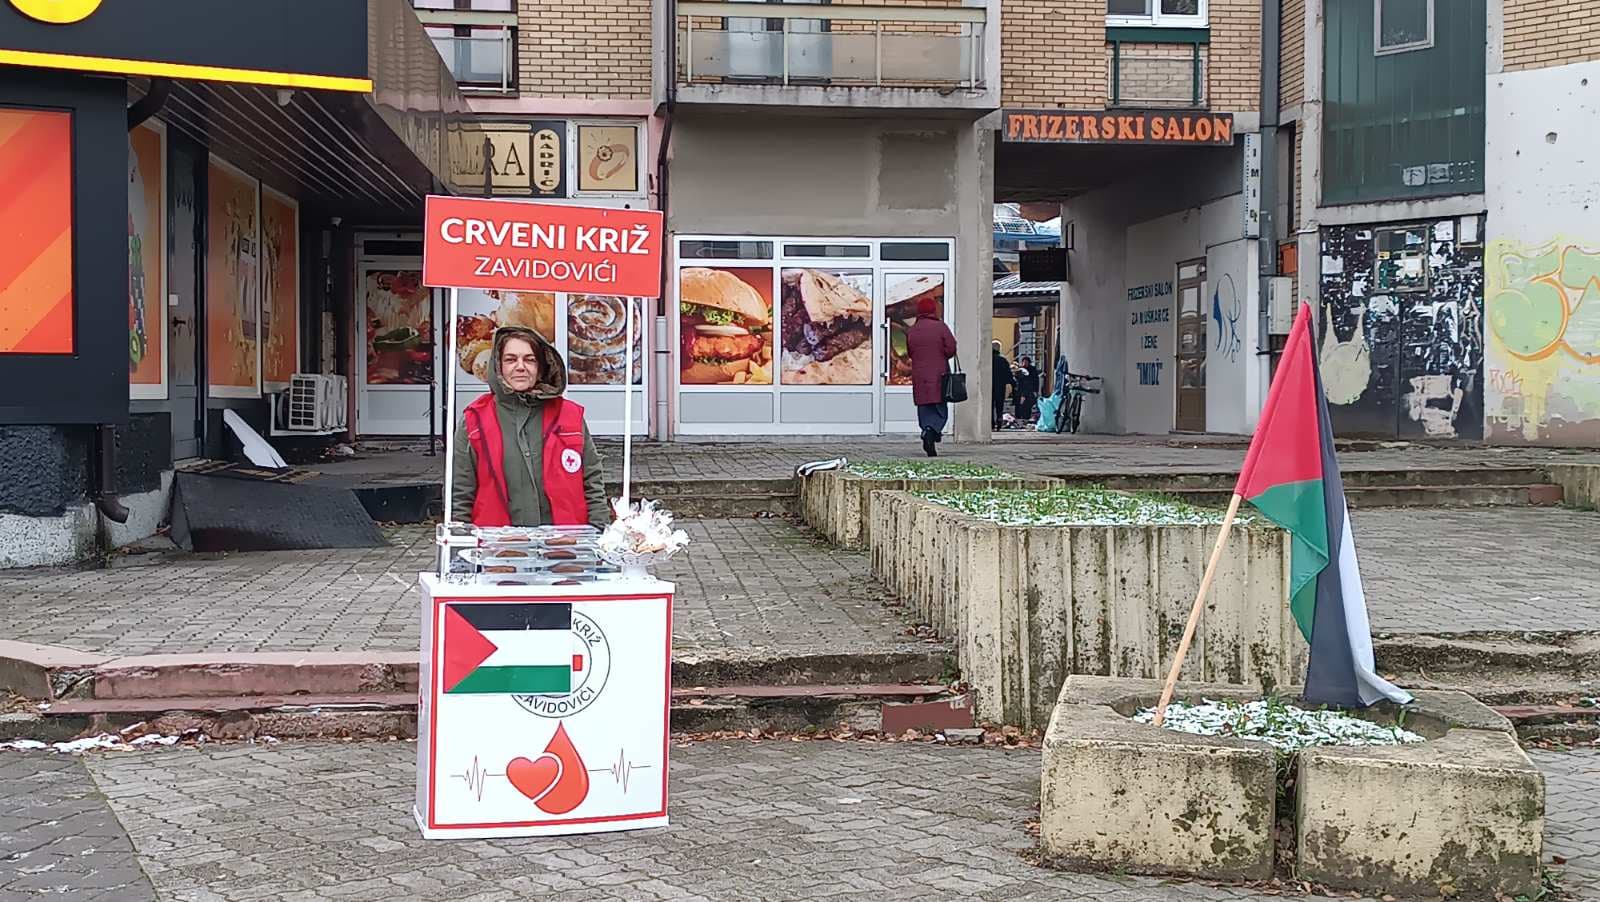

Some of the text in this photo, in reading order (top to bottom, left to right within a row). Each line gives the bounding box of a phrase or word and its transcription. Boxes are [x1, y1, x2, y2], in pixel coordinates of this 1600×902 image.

[1008, 114, 1232, 141] FRIZERSKI SALON
[440, 217, 650, 255] CRVENI KRIŽ
[474, 256, 617, 283] ZAVIDOVIĆI
[573, 618, 602, 647] KRIŽ
